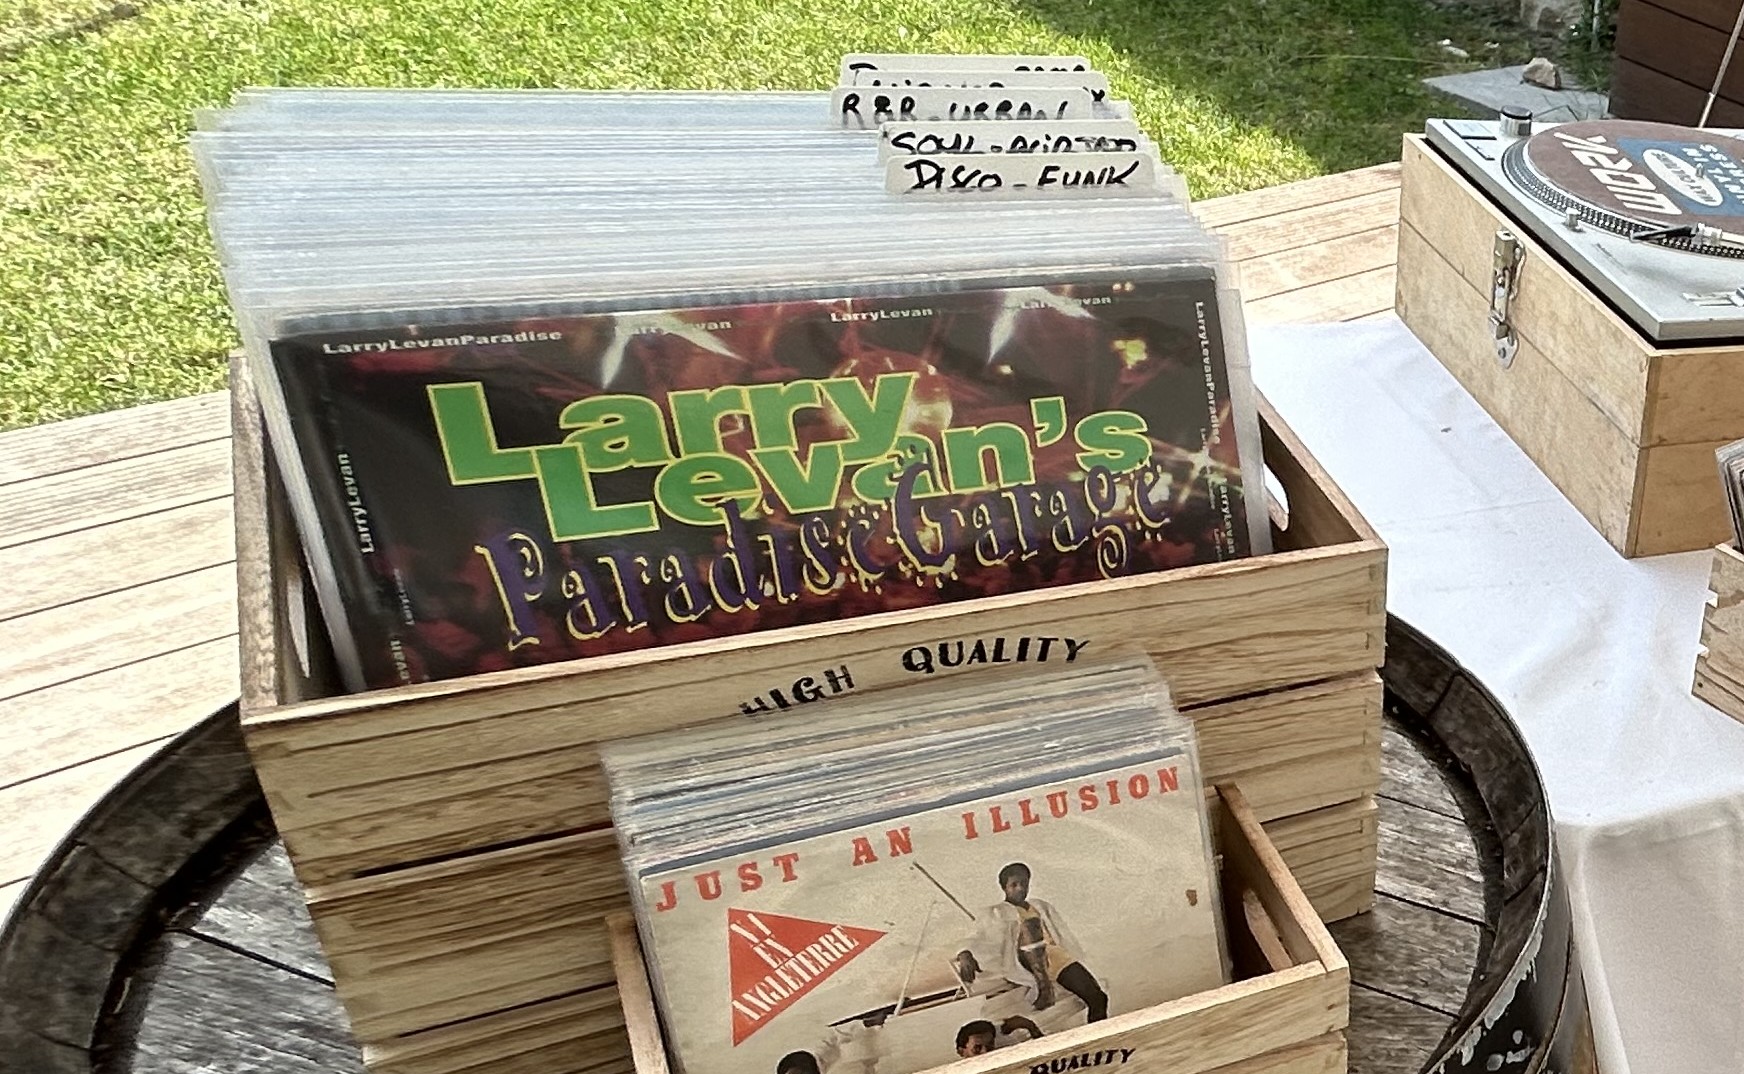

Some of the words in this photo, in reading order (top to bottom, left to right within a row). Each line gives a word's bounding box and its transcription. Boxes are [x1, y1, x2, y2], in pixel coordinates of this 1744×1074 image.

[1037, 160, 1140, 190] FUNK
[323, 329, 562, 355] LarryLevanParadise
[830, 307, 933, 323] LarryLevan
[425, 371, 919, 486] Larry
[531, 396, 1153, 543] Levan's
[337, 453, 375, 555] LarryLevan
[902, 637, 1091, 675] QUALITY
[656, 852, 801, 912] JUST
[853, 826, 914, 867] AN
[962, 767, 1181, 840] ILLUSION
[732, 924, 860, 1021] ANGLETERRE
